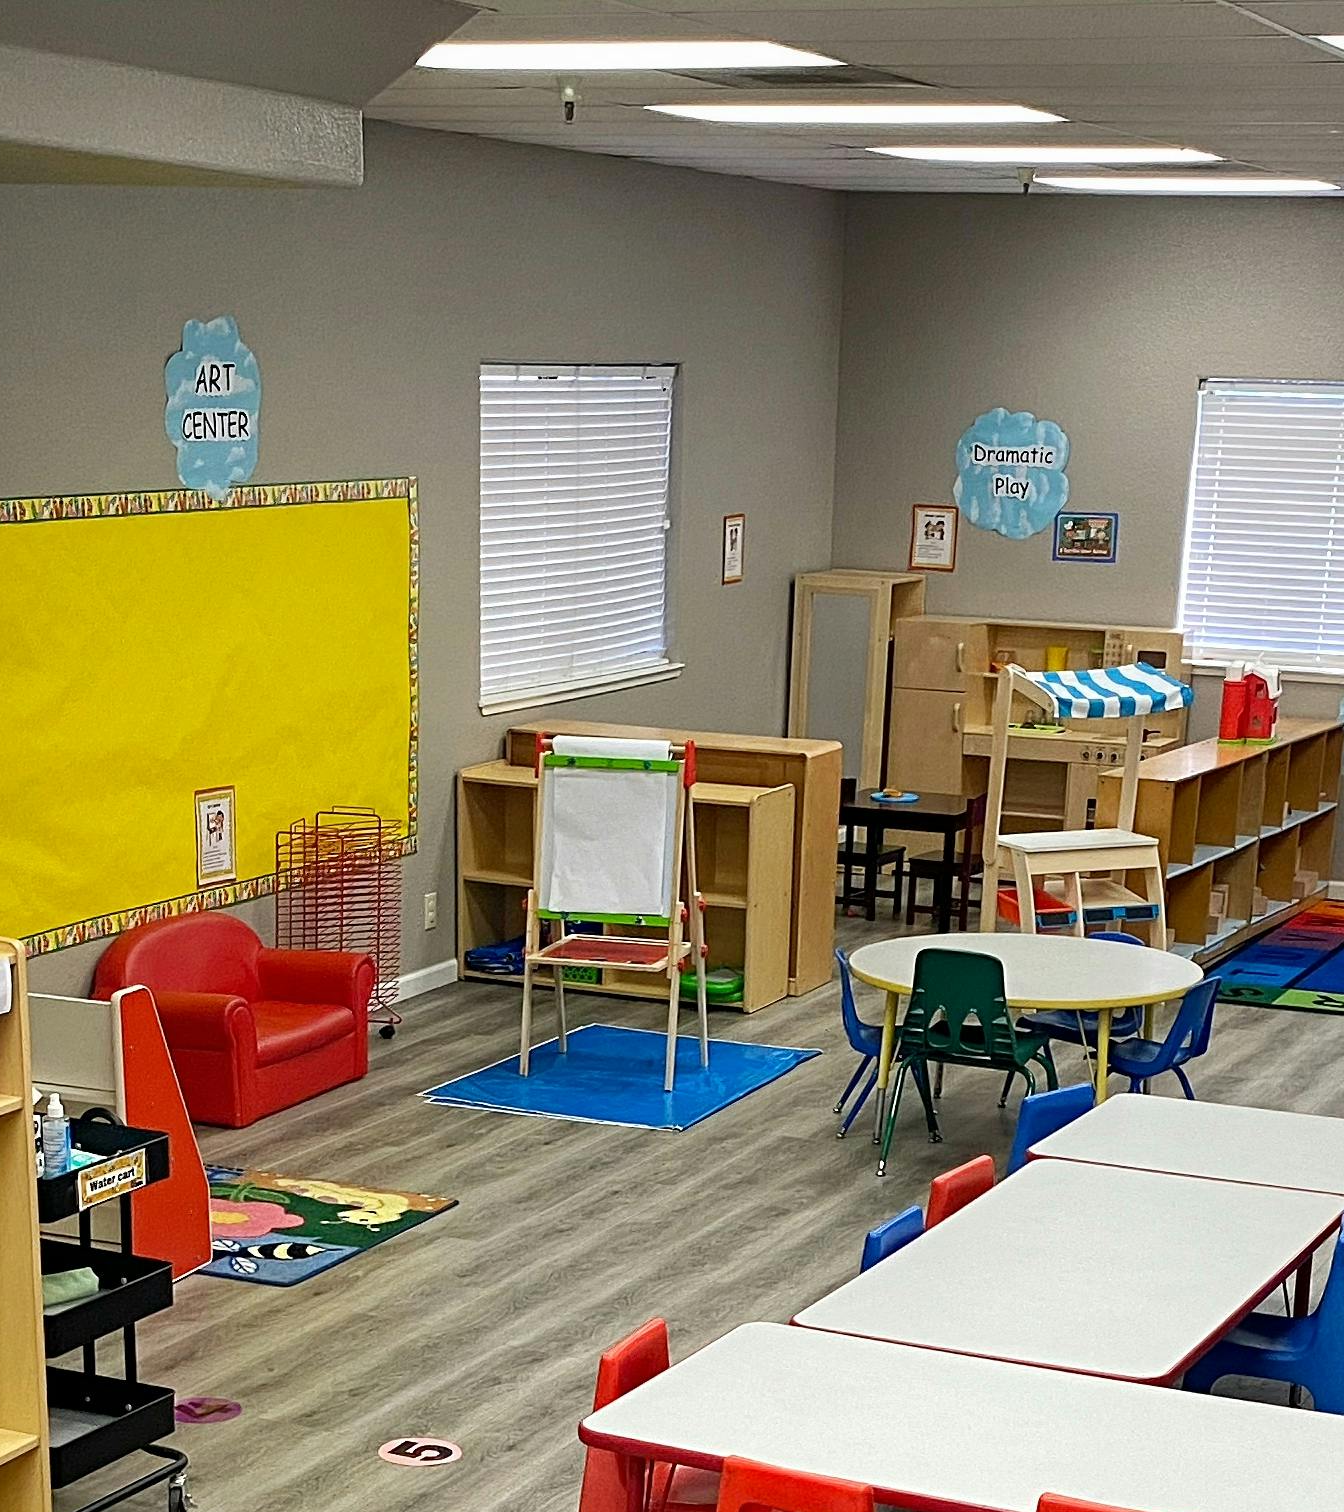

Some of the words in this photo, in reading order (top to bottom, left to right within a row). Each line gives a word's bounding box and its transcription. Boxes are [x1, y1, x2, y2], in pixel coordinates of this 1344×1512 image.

[195, 364, 235, 393] ART
[182, 411, 249, 439] CENTER
[974, 444, 1053, 464] Dramatic
[995, 477, 1030, 499] Play
[1220, 986, 1264, 999] S
[90, 1174, 116, 1191] Water
[117, 1167, 135, 1182] cart
[387, 1440, 453, 1461] 5
